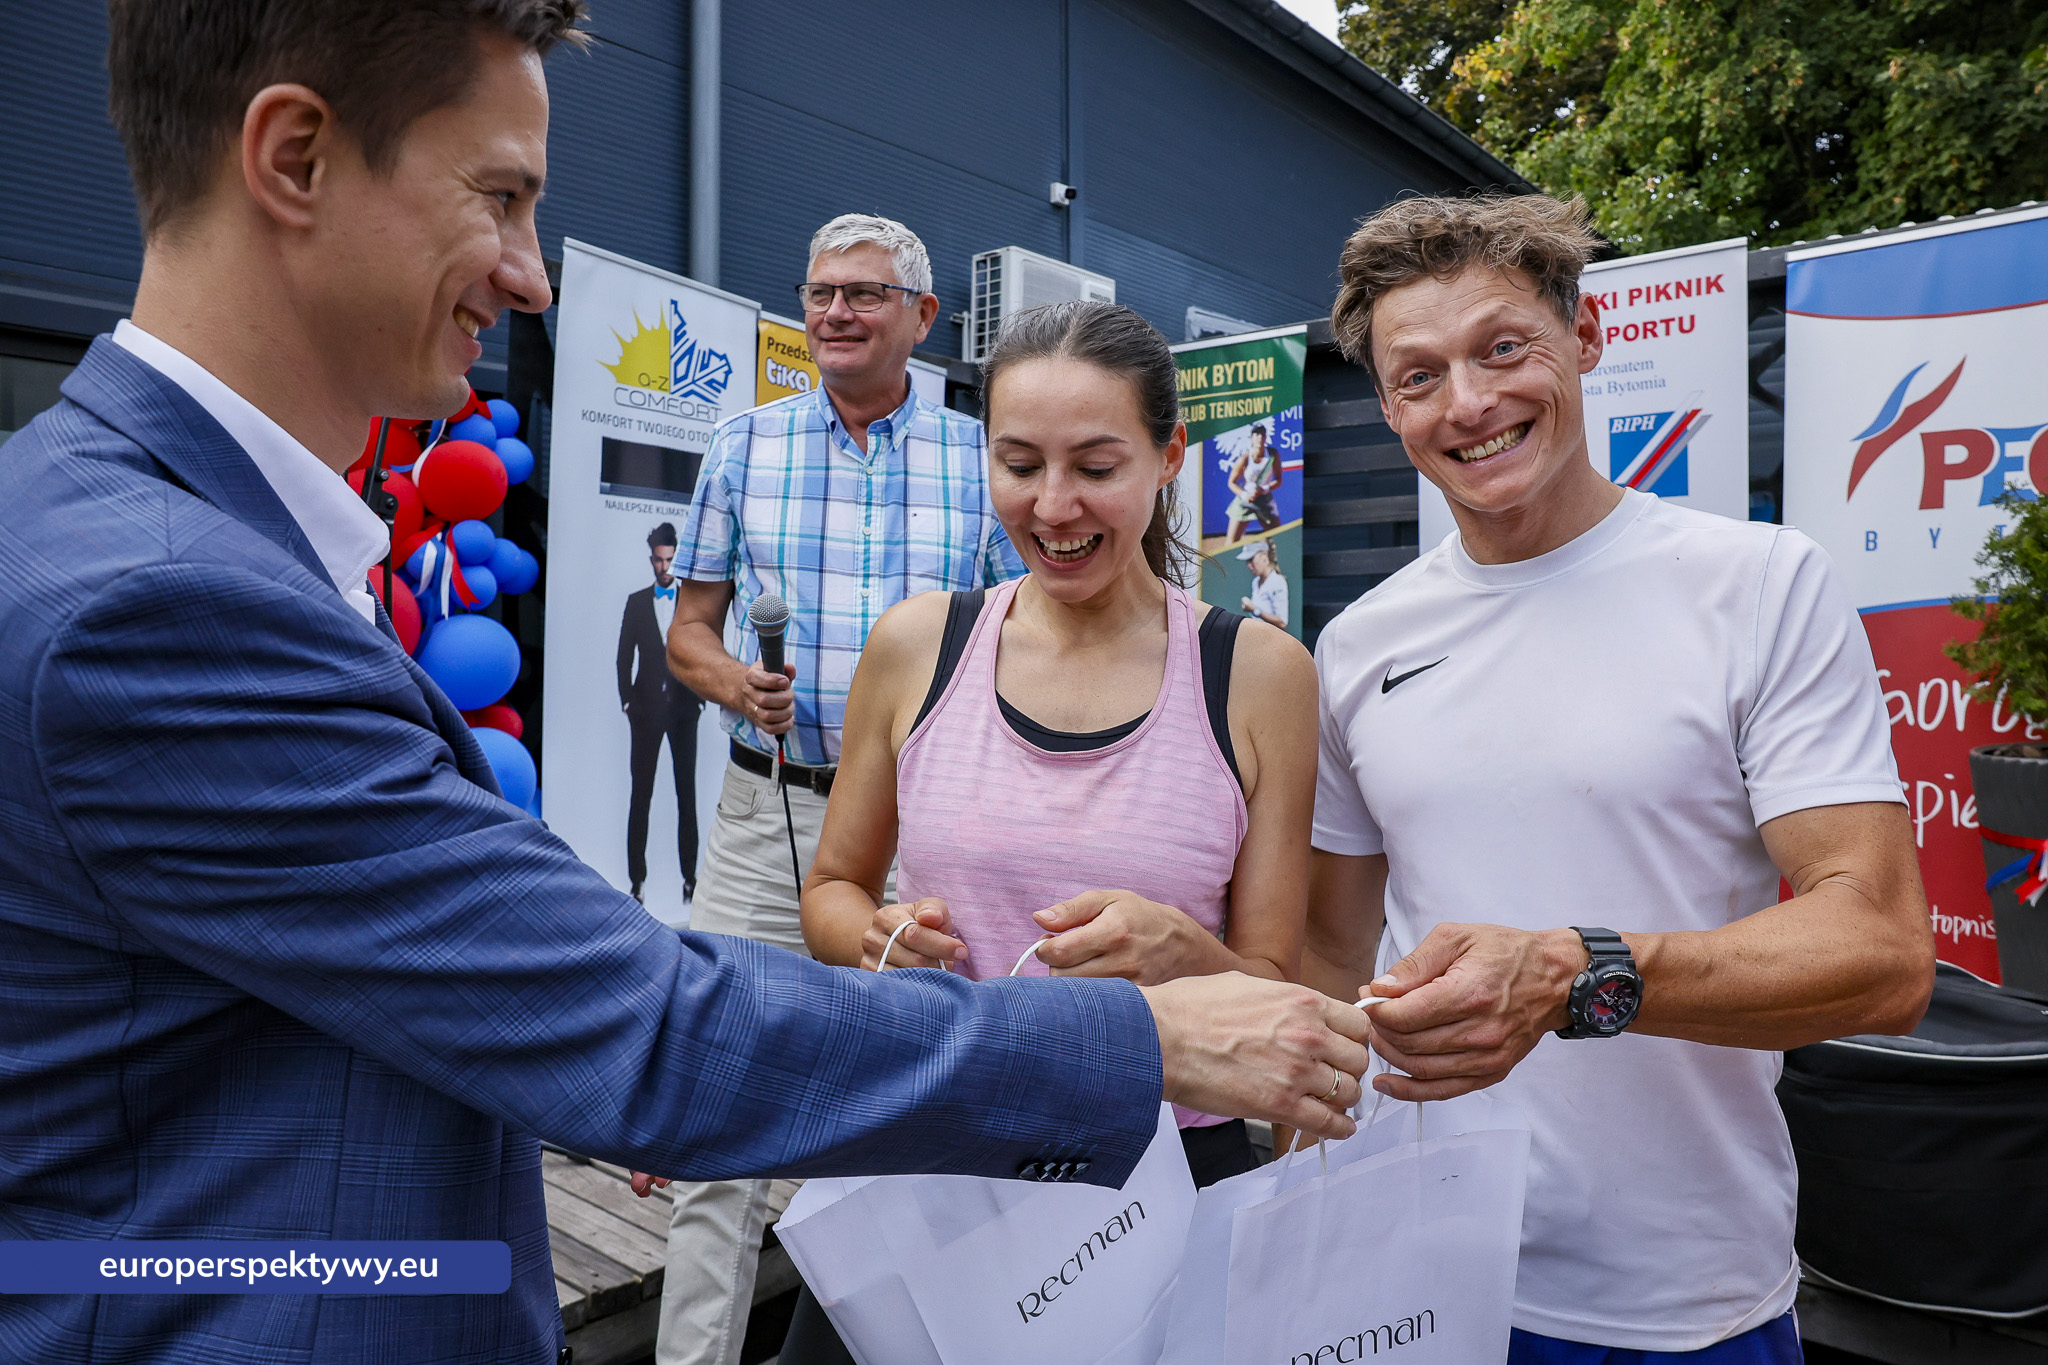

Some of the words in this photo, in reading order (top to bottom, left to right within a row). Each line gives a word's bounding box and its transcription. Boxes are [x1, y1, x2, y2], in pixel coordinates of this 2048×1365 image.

[1629, 273, 1725, 306] PIKNIK
[1601, 314, 1696, 344] PORTU
[1212, 357, 1275, 387] BYTOM
[1607, 375, 1666, 396] Bytomia
[614, 387, 722, 422] COMFORT
[1209, 396, 1273, 419] TENISOWY
[581, 409, 633, 430] KOMFORT
[636, 420, 685, 440] TWOJEGO
[1610, 415, 1657, 434] BIPH
[1280, 429, 1303, 451] Sp
[604, 499, 653, 514] NAJLEPSZE
[1902, 773, 1979, 848] pie
